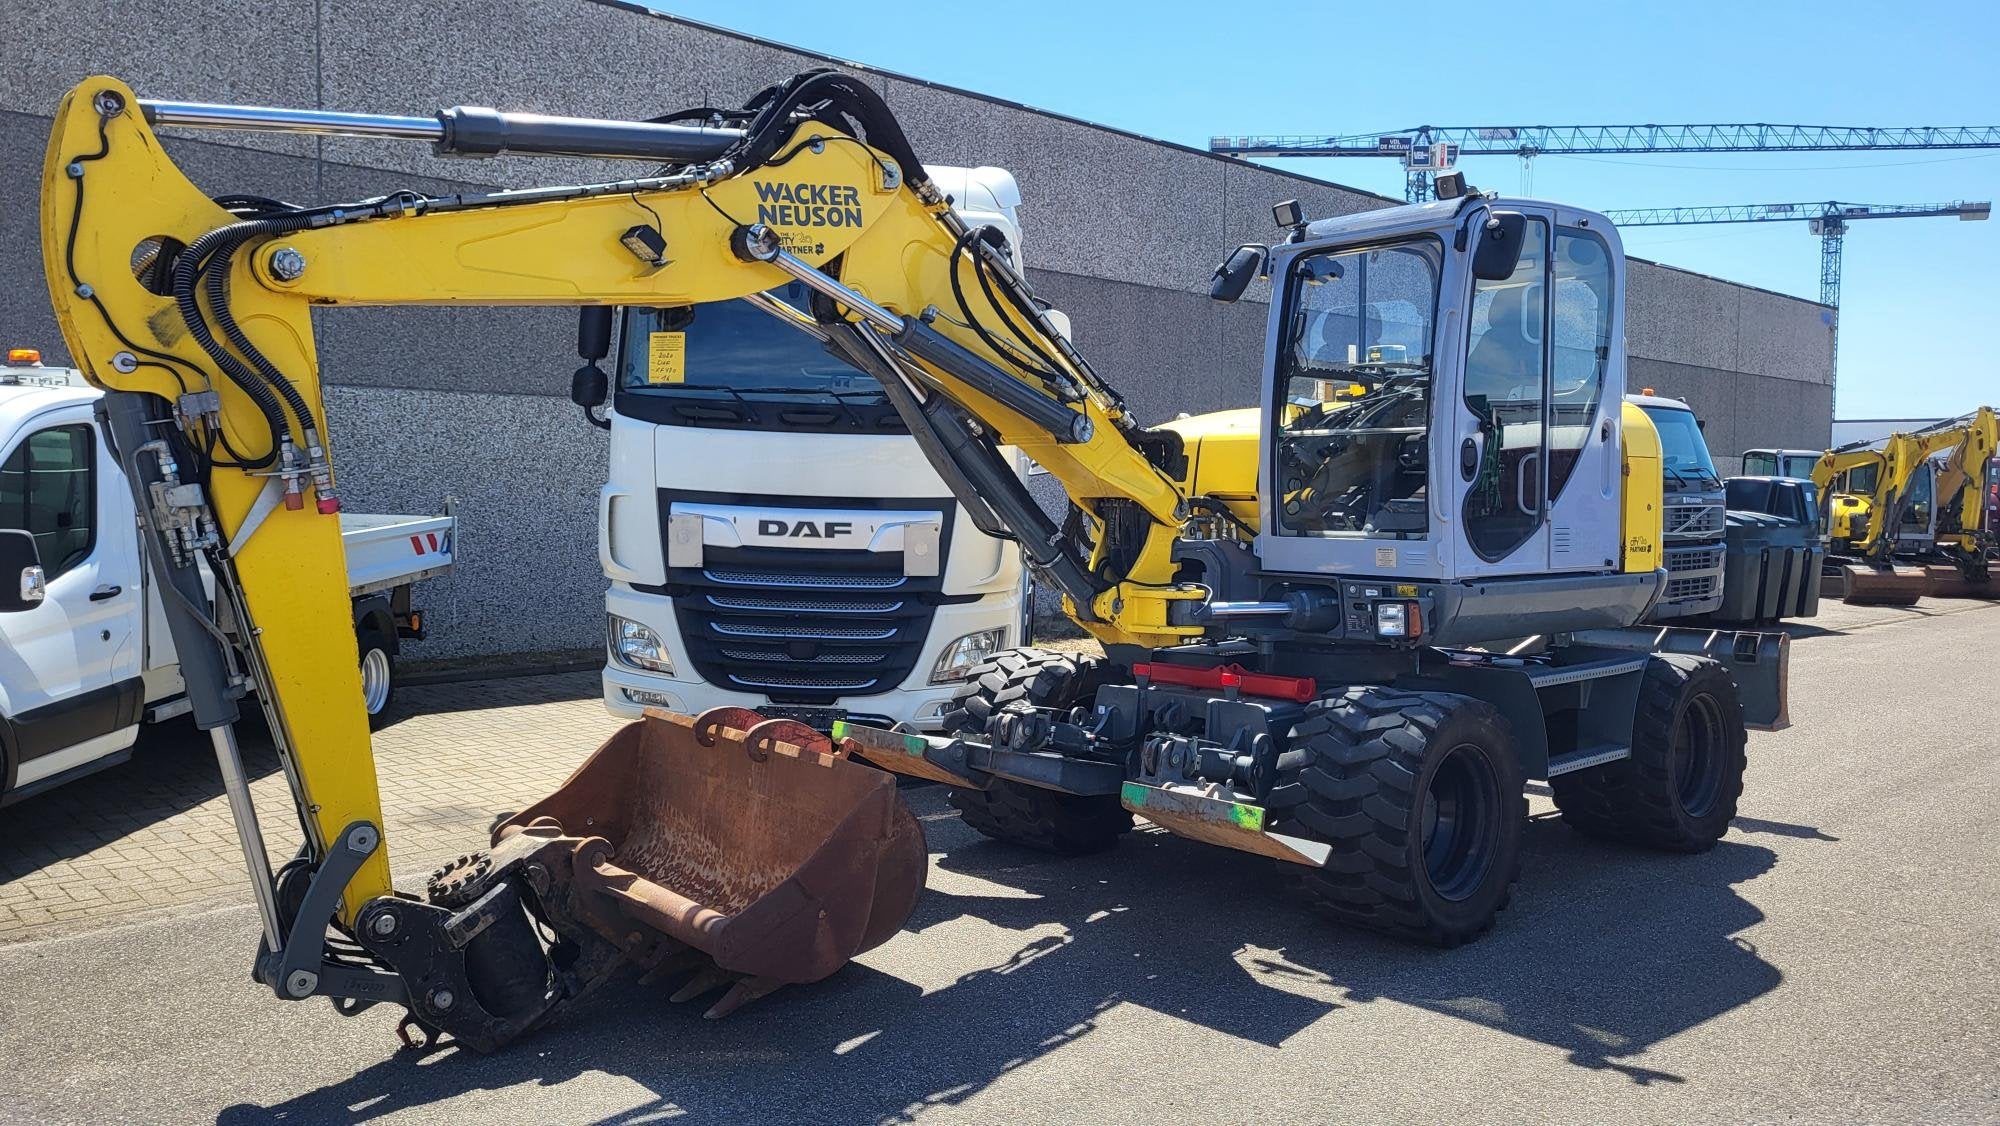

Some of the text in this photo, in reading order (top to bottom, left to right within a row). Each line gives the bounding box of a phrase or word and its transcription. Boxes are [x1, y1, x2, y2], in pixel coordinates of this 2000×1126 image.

[753, 181, 861, 207] WACKER
[758, 204, 863, 228] NEUSON
[758, 519, 852, 539] DAF
